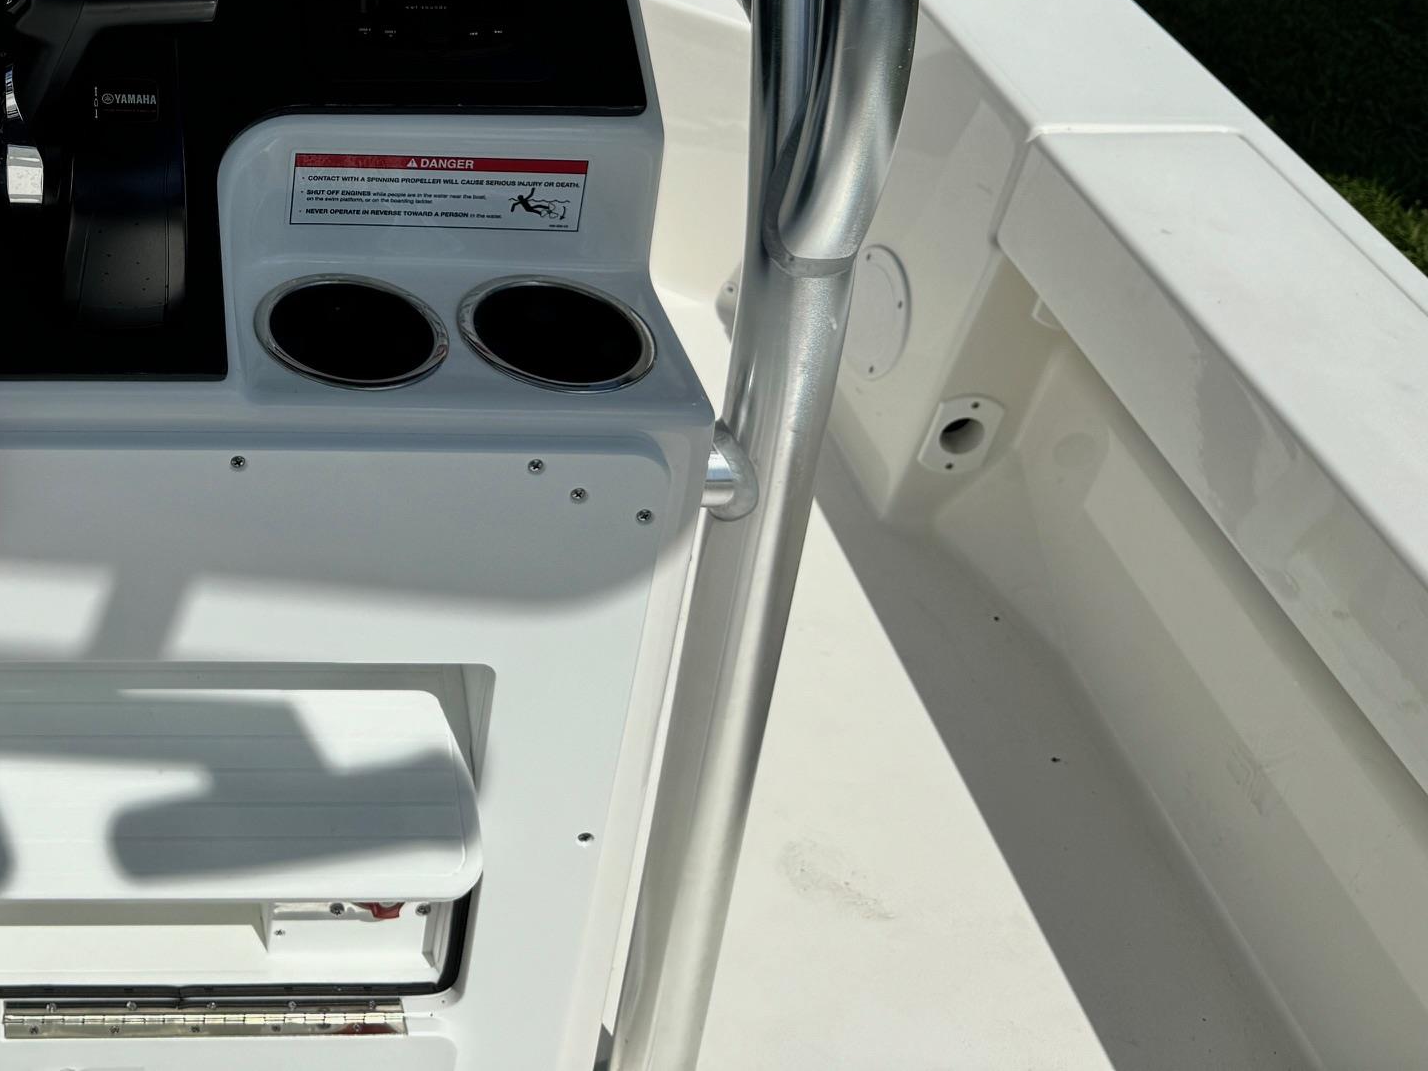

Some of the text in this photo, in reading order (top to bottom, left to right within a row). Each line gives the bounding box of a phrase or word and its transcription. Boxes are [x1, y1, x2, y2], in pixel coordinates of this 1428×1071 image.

[114, 93, 157, 105] YAMAHA
[420, 158, 474, 170] DANGER
[401, 177, 442, 185] PROPELLER
[485, 179, 516, 187] SERIOUS
[370, 209, 402, 217] REVERSE
